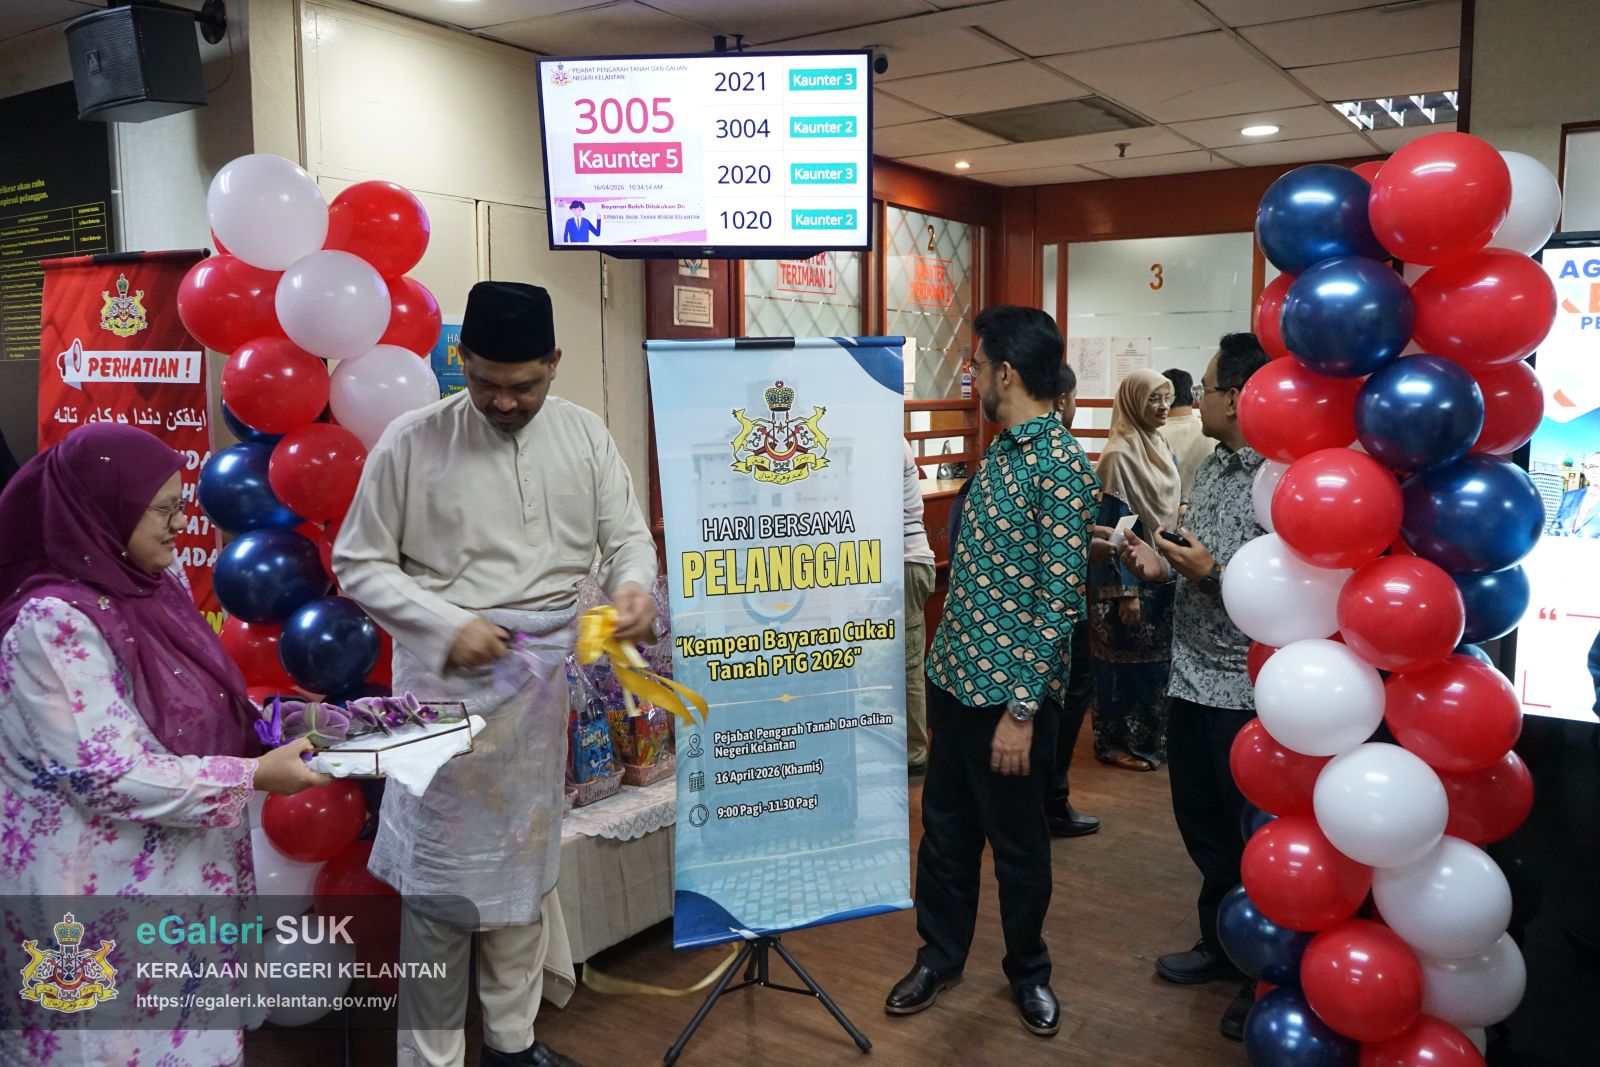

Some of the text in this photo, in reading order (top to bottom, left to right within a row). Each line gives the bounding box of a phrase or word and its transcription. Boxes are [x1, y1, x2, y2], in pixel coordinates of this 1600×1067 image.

[715, 72, 765, 92] 2021
[793, 74, 853, 86] Kaunter 3
[575, 98, 674, 134] 3005
[716, 119, 770, 138] 3004
[793, 121, 853, 134] Kaunter 2
[578, 148, 679, 168] Kaunter 5
[718, 165, 771, 184] 2020
[794, 168, 854, 180] Kaunter 3
[720, 211, 772, 230] 1020
[795, 214, 854, 226] Kaunter 2
[928, 224, 935, 252] 2
[780, 264, 833, 288] TERIMAAN 1
[1150, 264, 1164, 290] 3
[88, 358, 192, 378] PERHATIAN !
[702, 510, 856, 542] HARI BERSAMA
[682, 539, 881, 598] PELANGGAN
[763, 626, 840, 652] Bayaran
[842, 618, 896, 642] Cukai
[707, 656, 770, 681] Tanah
[772, 654, 808, 675] PTG
[714, 713, 892, 746] Pejabat Pengarah Tanah Dan Galian
[714, 739, 796, 760] Negeri Kelantan
[716, 760, 824, 784] 16 April 2026 (Khamis)
[717, 806, 739, 820] 9:00
[740, 803, 763, 818] Pagi
[768, 800, 795, 814] 11.30
[796, 794, 818, 810] Pagi
